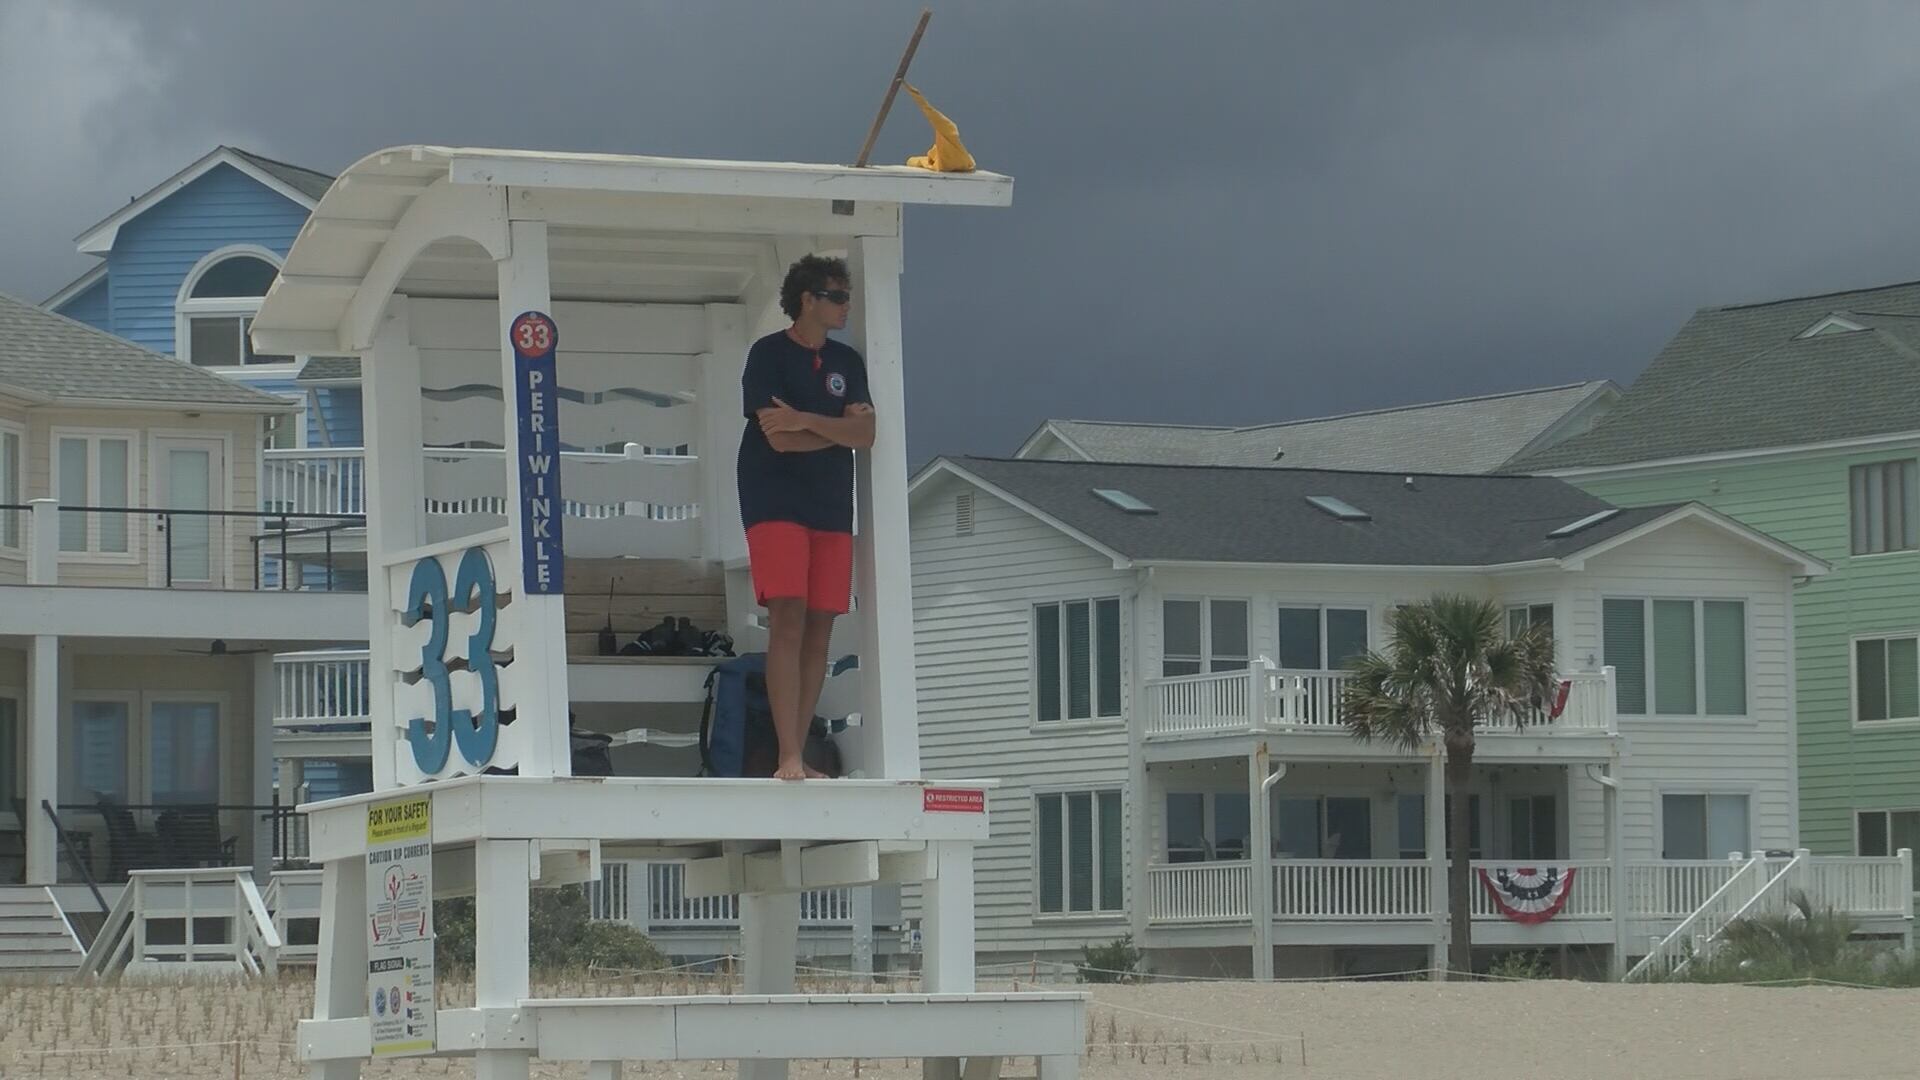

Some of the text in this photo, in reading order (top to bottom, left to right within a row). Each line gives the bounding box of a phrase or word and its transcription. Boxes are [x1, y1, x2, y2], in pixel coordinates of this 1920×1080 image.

[520, 324, 549, 349] 33
[529, 370, 551, 583] PERIWINKLE
[408, 545, 498, 775] 33
[936, 794, 968, 802] RESTRICTED
[369, 801, 430, 827] FOR YOUR SAFETY
[369, 843, 430, 864] CAUTION RIP CURRENTS
[374, 960, 386, 971] FLAG
